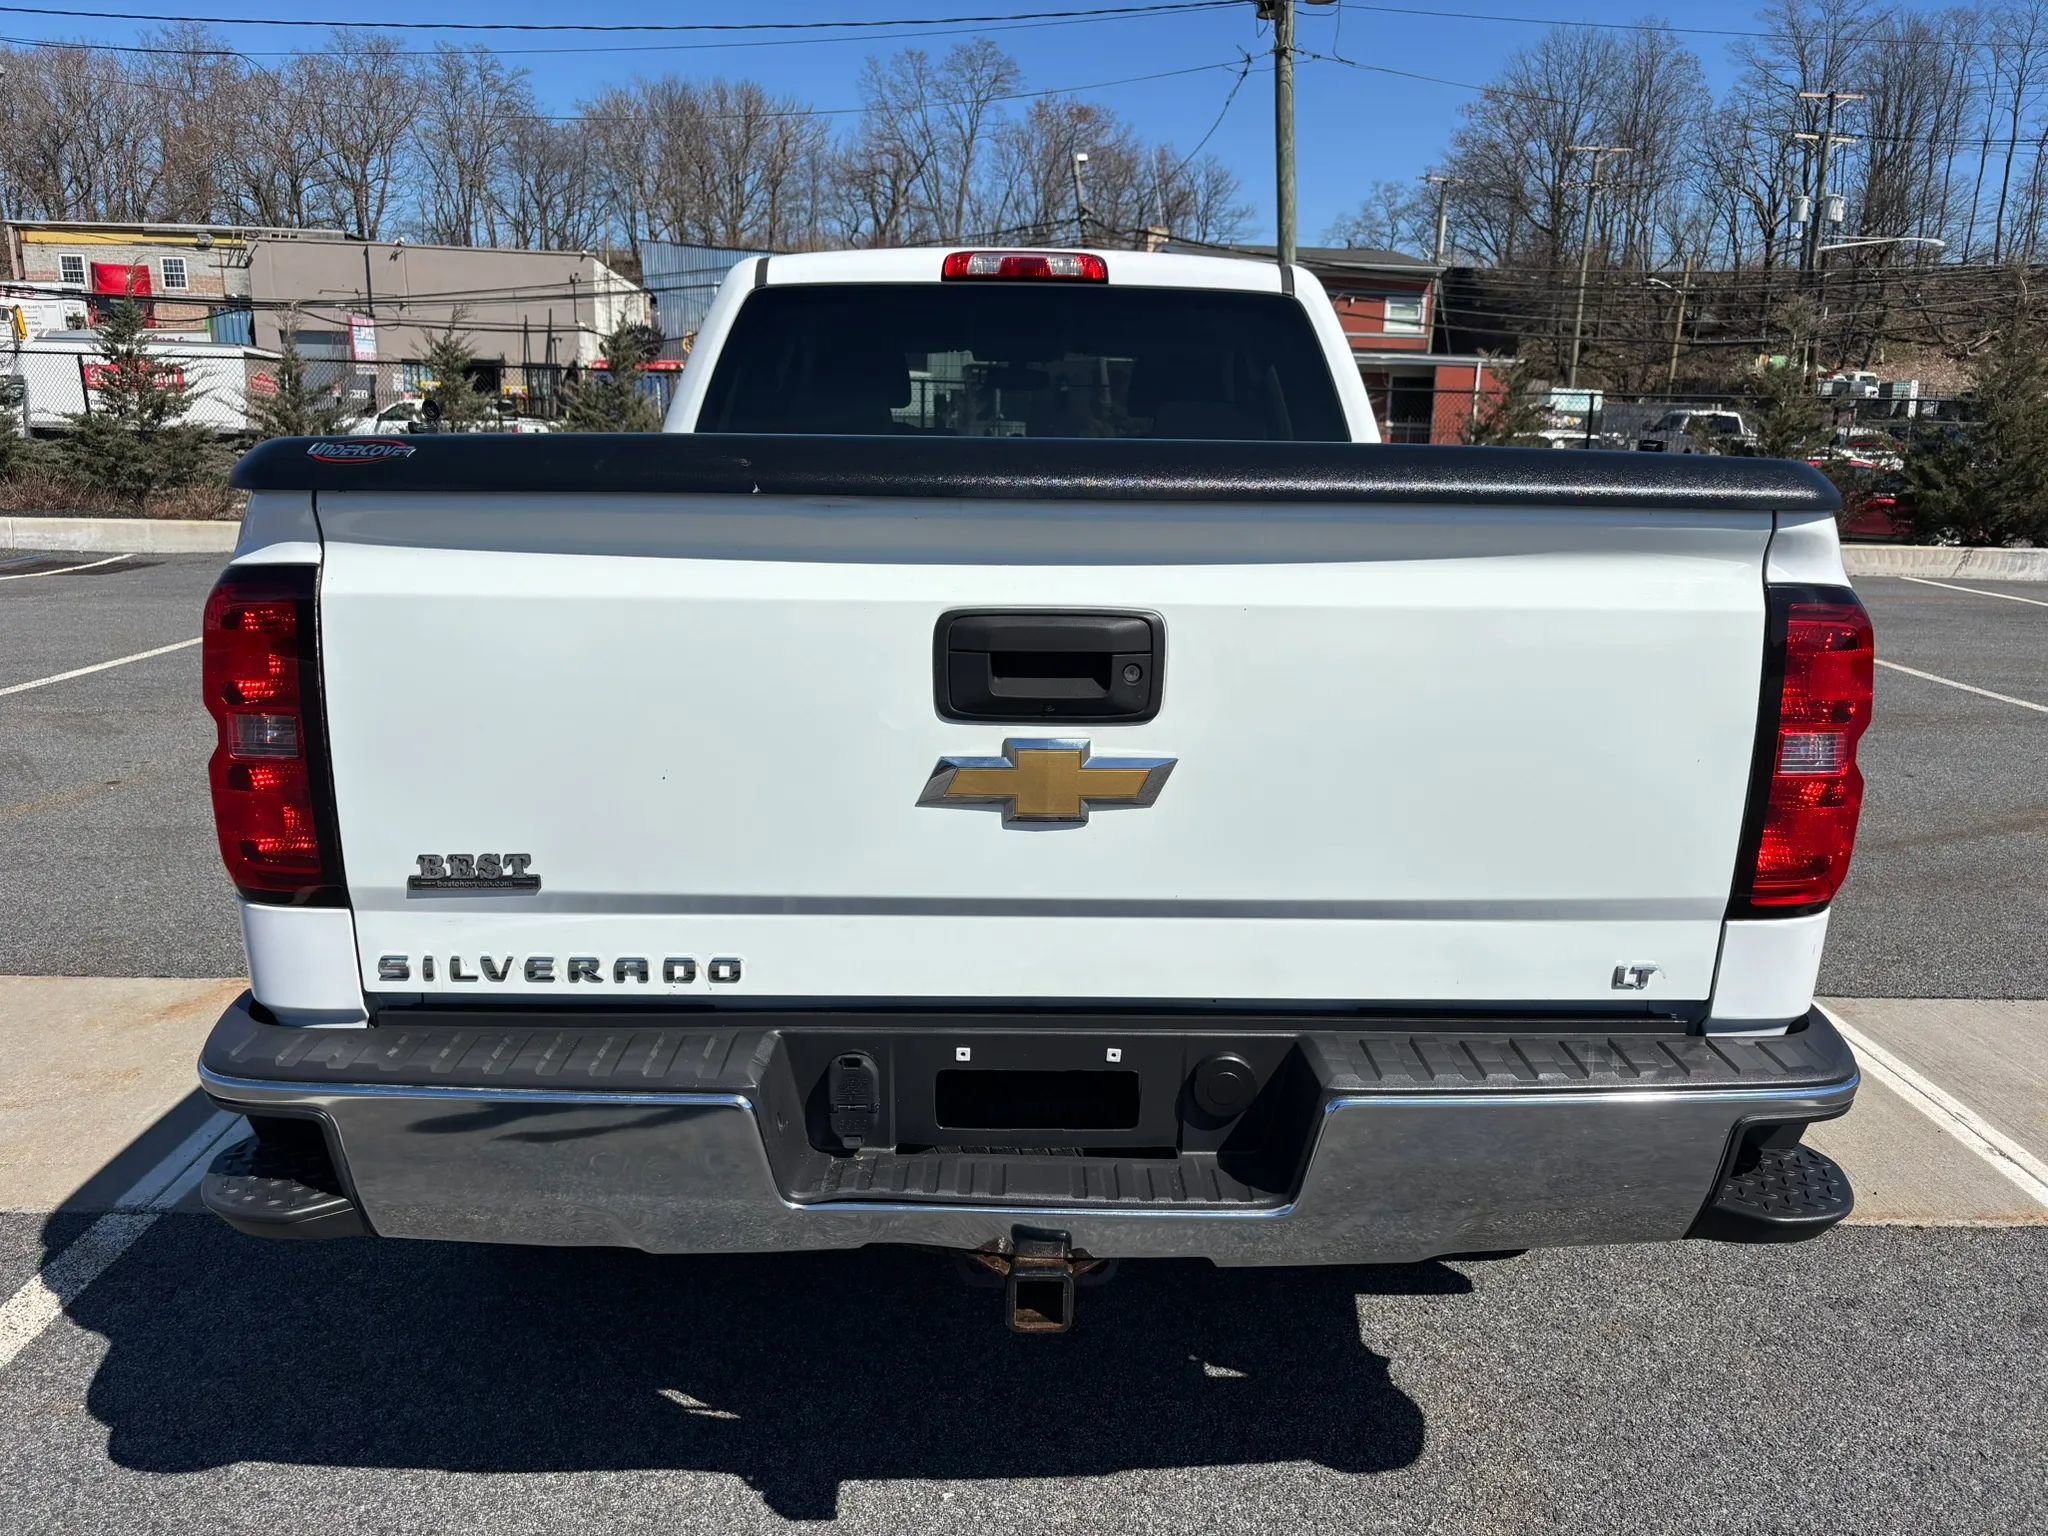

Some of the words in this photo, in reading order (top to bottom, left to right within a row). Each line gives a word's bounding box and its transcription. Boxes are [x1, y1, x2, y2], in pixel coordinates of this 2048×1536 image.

[306, 442, 417, 458] UNDERCOVER
[416, 853, 532, 879] BEST
[378, 955, 742, 983] SILVERADO
[1611, 966, 1658, 990] LT
